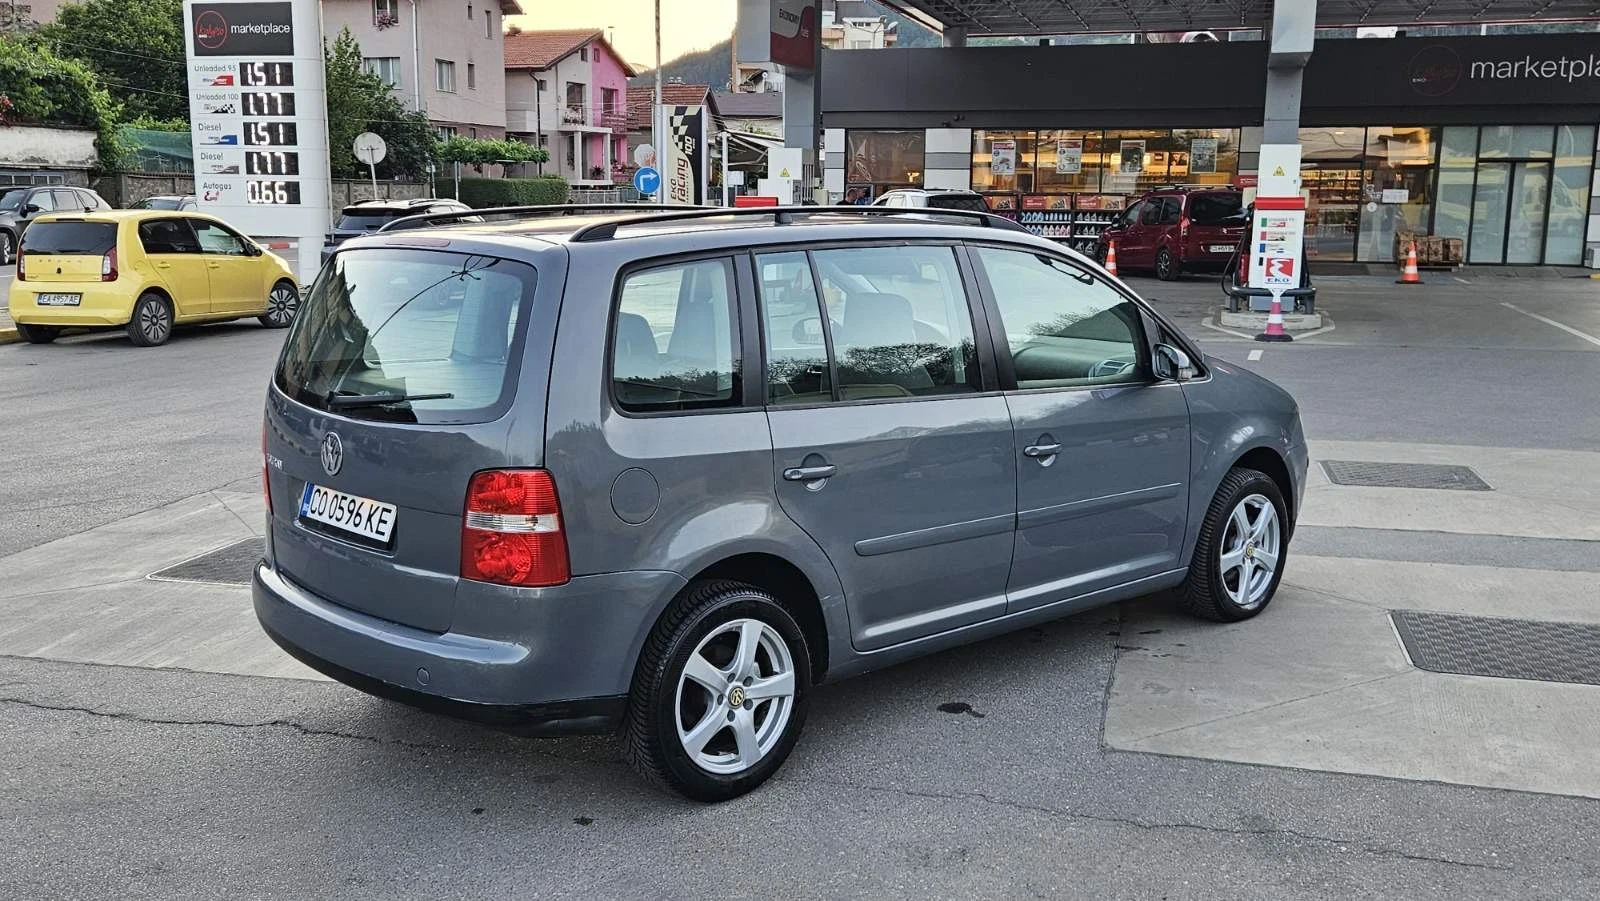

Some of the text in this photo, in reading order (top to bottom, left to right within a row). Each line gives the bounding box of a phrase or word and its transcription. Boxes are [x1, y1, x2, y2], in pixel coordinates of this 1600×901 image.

[231, 22, 291, 36] marketplace
[227, 64, 237, 72] 95
[228, 93, 239, 101] 100
[198, 122, 222, 131] Diesel
[684, 135, 693, 156] 100
[200, 152, 224, 161] Diesel
[677, 157, 688, 203] racing
[202, 182, 233, 192] Autogas
[310, 488, 393, 537] CO 0596 KE
